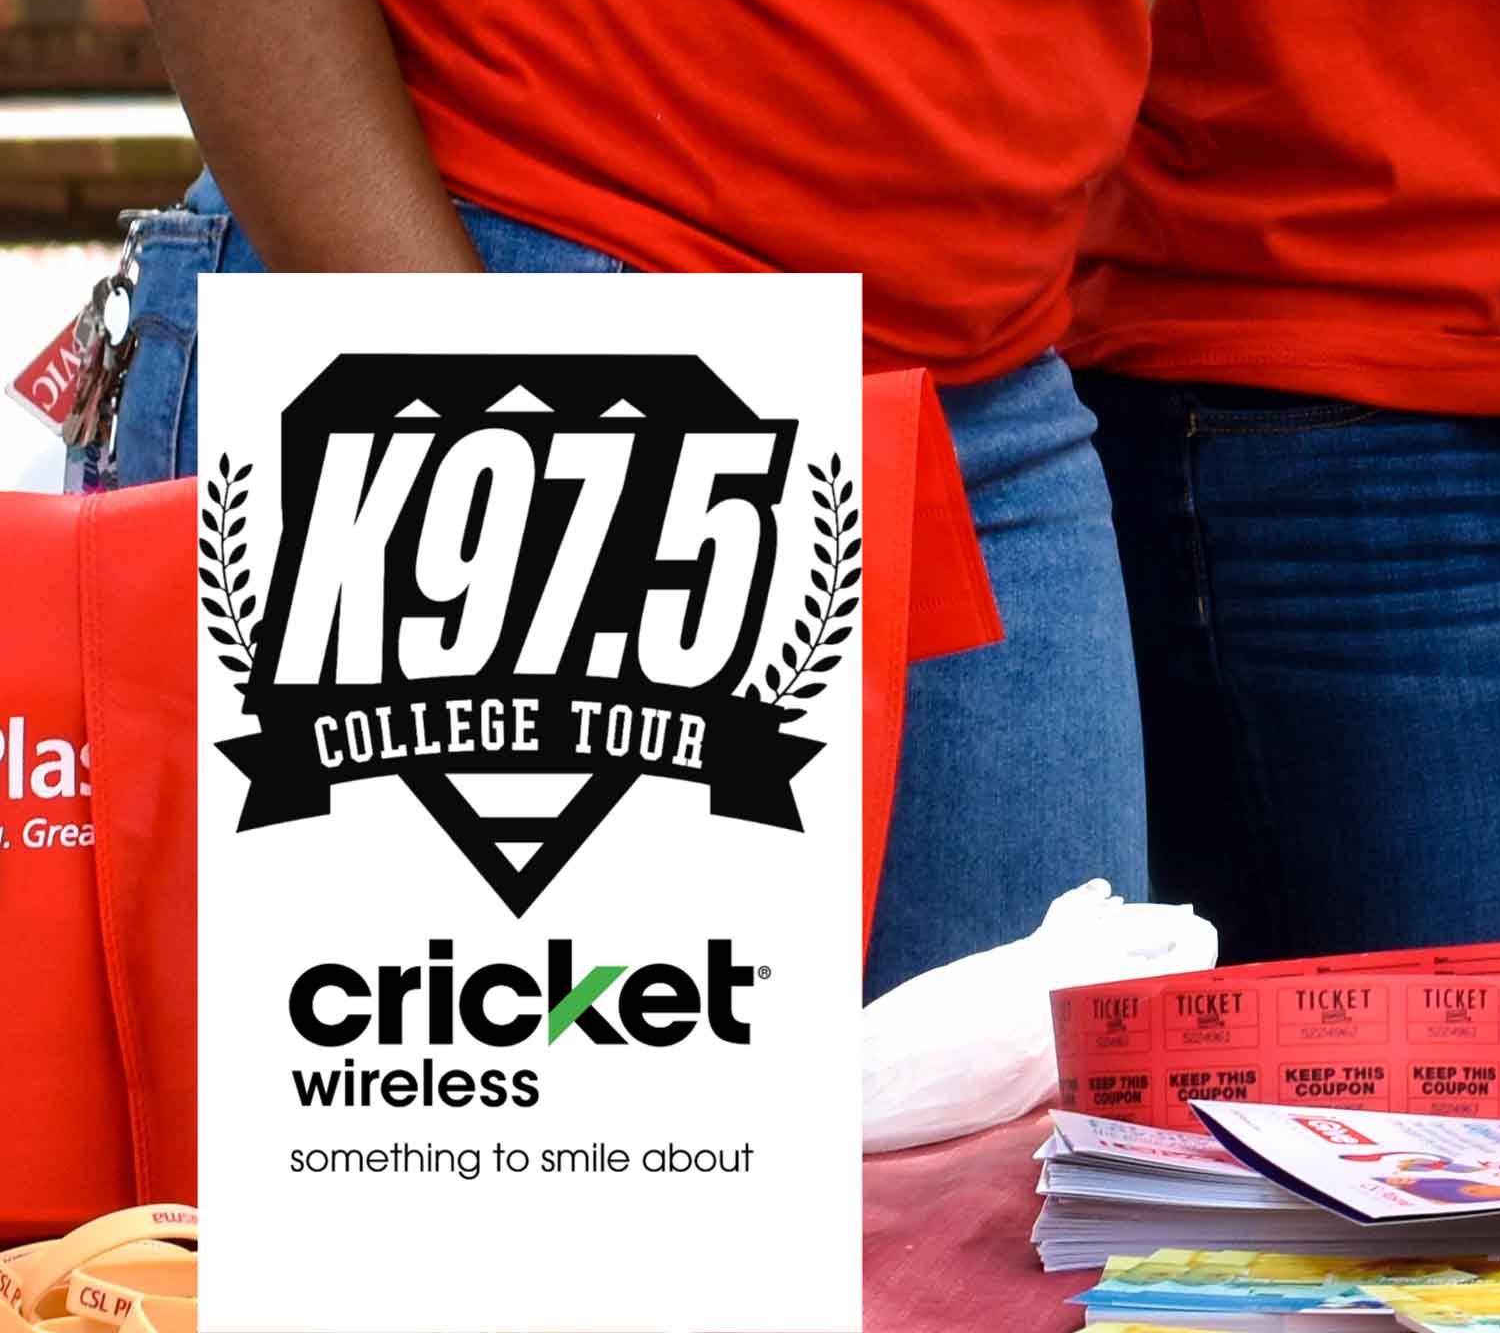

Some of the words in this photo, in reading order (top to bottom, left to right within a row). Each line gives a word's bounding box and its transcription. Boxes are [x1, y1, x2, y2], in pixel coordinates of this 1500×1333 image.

[1177, 992, 1242, 1013] TICKET
[1297, 989, 1371, 1010] TICKET
[1423, 988, 1487, 1009] TICKET
[1092, 997, 1139, 1019] TICKET
[1169, 1072, 1210, 1087] KEEP
[1217, 1070, 1256, 1084] THIS
[1286, 1068, 1336, 1082] KEEP
[1342, 1067, 1384, 1080] THIS
[1413, 1067, 1457, 1081] KEEP
[1463, 1068, 1496, 1081] THIS
[1089, 1076, 1116, 1090] KEEP
[1120, 1075, 1148, 1089] THIS
[1296, 1083, 1375, 1096] COUPON
[1422, 1082, 1489, 1095] COUPON
[1094, 1092, 1141, 1104] COUPON
[1178, 1087, 1247, 1101] COUPON
[80, 1286, 108, 1312] CSL
